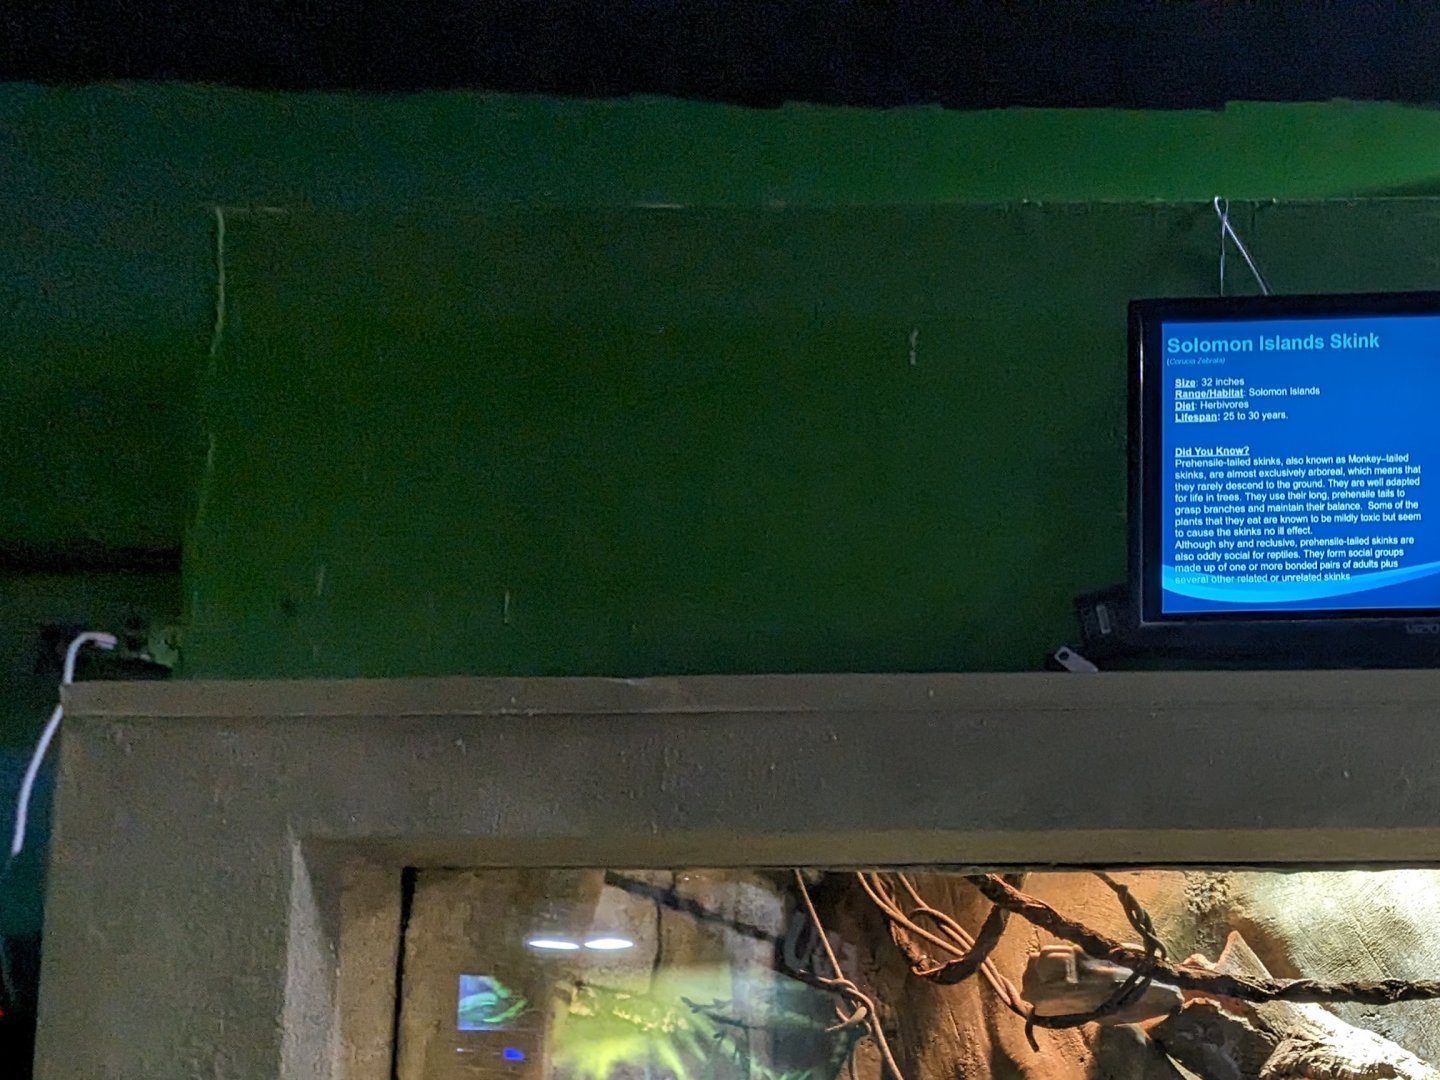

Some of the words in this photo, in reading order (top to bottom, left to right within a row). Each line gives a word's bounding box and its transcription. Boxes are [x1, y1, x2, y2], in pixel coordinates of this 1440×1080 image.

[1167, 336, 1252, 353] Solomon
[1259, 334, 1324, 350] Islands
[1330, 332, 1379, 348] Skink
[1174, 378, 1198, 388] Size:
[1201, 377, 1212, 386] 32
[1215, 377, 1244, 385] inches
[1174, 388, 1245, 400] Range/Habitat:
[1248, 387, 1287, 396] Solomon
[1289, 386, 1320, 395] Islands
[1174, 401, 1197, 411] Diet:
[1200, 399, 1249, 409] Herbivores
[1174, 412, 1220, 423] Lifespan:
[1223, 411, 1234, 420] 25
[1236, 411, 1246, 420] to
[1248, 410, 1259, 420] 30
[1261, 412, 1288, 421] years.
[1175, 447, 1192, 457] Did
[1194, 447, 1213, 457] You
[1215, 446, 1249, 456] Know?
[1175, 457, 1251, 467] Prehensile-tailed
[1253, 456, 1283, 466] skinks,
[1285, 456, 1304, 465] also
[1305, 455, 1333, 464] known
[1335, 456, 1346, 464] as
[1174, 470, 1206, 480] skinks,
[1226, 469, 1256, 478] almost
[1258, 467, 1306, 479] exclusively
[1307, 466, 1345, 476] arboreal,
[1347, 466, 1372, 475] which
[1374, 466, 1402, 474] means
[1404, 465, 1421, 473] that
[1174, 482, 1195, 492] they
[1197, 481, 1223, 492] rarely
[1225, 480, 1263, 490] descend
[1265, 480, 1275, 489] to
[1276, 480, 1290, 488] the
[1292, 478, 1325, 490] ground.
[1327, 478, 1349, 489] They
[1350, 479, 1365, 487] are
[1366, 477, 1383, 486] well
[1385, 476, 1420, 487] adapted
[1174, 493, 1187, 502] for
[1189, 491, 1203, 502] life
[1205, 493, 1214, 501] in
[1216, 490, 1241, 501] trees.
[1244, 491, 1267, 502] They
[1287, 489, 1307, 499] their
[1308, 490, 1329, 500] long,
[1331, 489, 1375, 500] prehensile
[1377, 488, 1394, 497] tails
[1396, 488, 1405, 497] to
[1174, 506, 1201, 515] grasp
[1203, 504, 1245, 513] branches
[1247, 501, 1265, 512] and
[1266, 502, 1304, 512] maintain
[1305, 502, 1325, 511] their
[1326, 501, 1362, 510] balance.
[1367, 500, 1392, 510] Some
[1394, 500, 1403, 509] of
[1404, 500, 1418, 509] the
[1174, 517, 1203, 527] plants
[1205, 516, 1222, 525] that
[1224, 516, 1244, 526] they
[1246, 515, 1261, 524] eat
[1263, 516, 1278, 524] are
[1279, 514, 1308, 523] known
[1310, 514, 1319, 522] to
[1320, 514, 1332, 522] be
[1333, 513, 1358, 524] mildly
[1360, 512, 1380, 521] toxic
[1382, 512, 1396, 521] but
[1397, 513, 1421, 521] seem
[1174, 529, 1184, 537] to
[1186, 529, 1214, 537] cause
[1216, 527, 1231, 536] the
[1233, 525, 1261, 536] skinks
[1286, 525, 1312, 535] effect.
[1174, 539, 1216, 550] Although
[1218, 539, 1234, 549] shy
[1236, 539, 1254, 548] and
[1256, 538, 1297, 548] reclusive,
[1299, 536, 1369, 547] prehensile-tailed
[1371, 535, 1398, 544] skinks
[1400, 536, 1414, 544] are
[1174, 552, 1194, 561] also
[1196, 549, 1222, 562] oddly
[1224, 548, 1250, 560] social
[1252, 550, 1264, 559] for
[1266, 550, 1300, 560] reptiles.
[1303, 548, 1325, 559] They
[1326, 548, 1346, 557] form
[1348, 548, 1372, 557] social
[1374, 548, 1404, 558] groups
[1175, 563, 1201, 572] made
[1203, 564, 1215, 573] up
[1217, 562, 1227, 571] of
[1248, 563, 1258, 571] or
[1284, 560, 1317, 570] bonded
[1319, 558, 1340, 570] pairs
[1342, 559, 1351, 568] of
[1352, 557, 1378, 568] adults
[1380, 557, 1398, 569] plus
[1175, 575, 1209, 584] several
[1211, 574, 1235, 583] other
[1236, 573, 1267, 583] related
[1281, 572, 1322, 582] unrelated
